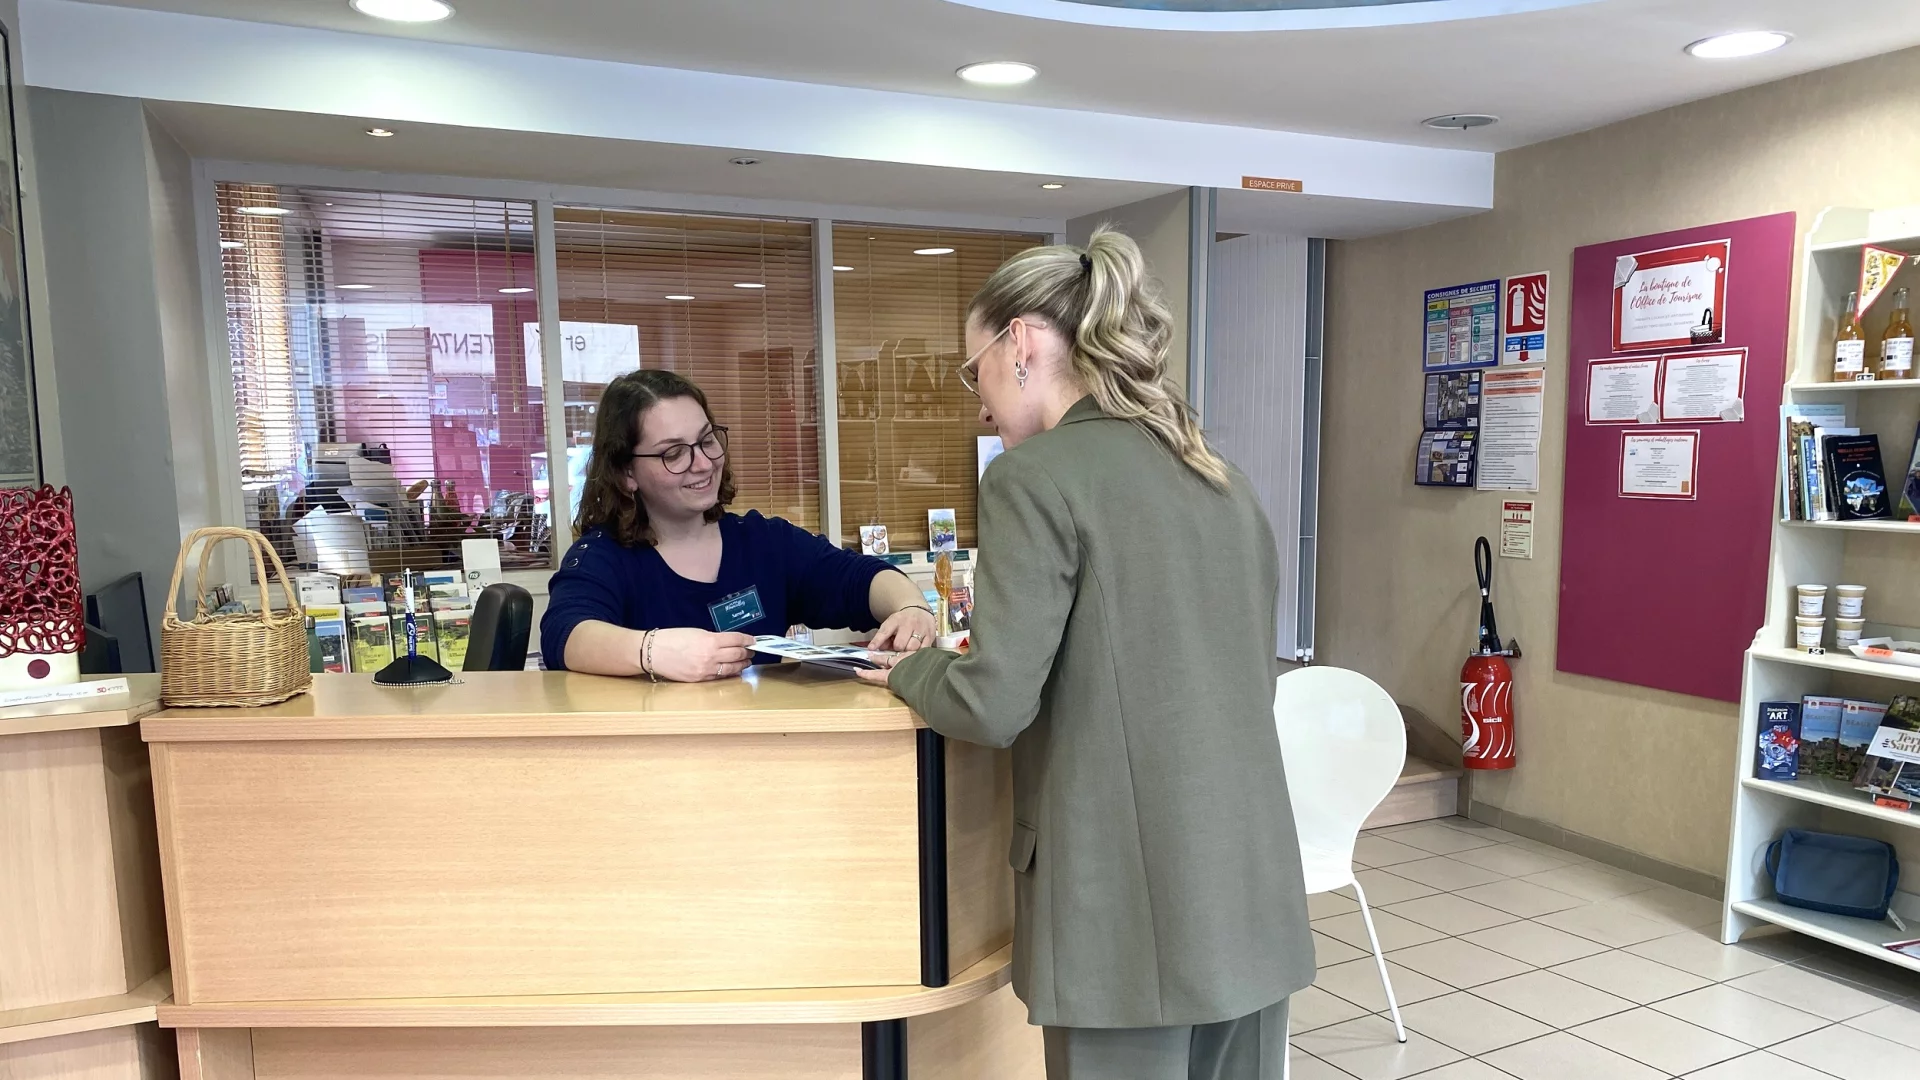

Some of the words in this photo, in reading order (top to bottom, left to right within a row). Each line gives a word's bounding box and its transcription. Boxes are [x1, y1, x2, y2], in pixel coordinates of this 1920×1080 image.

[1249, 180, 1275, 189] ESPACE
[1639, 281, 1648, 293] La
[1650, 277, 1679, 292] boutique
[1681, 275, 1692, 288] de
[1427, 289, 1460, 299] CONSIGNES
[1630, 294, 1656, 309] l'Office
[1656, 293, 1667, 305] de
[1668, 291, 1702, 304] Tourisme
